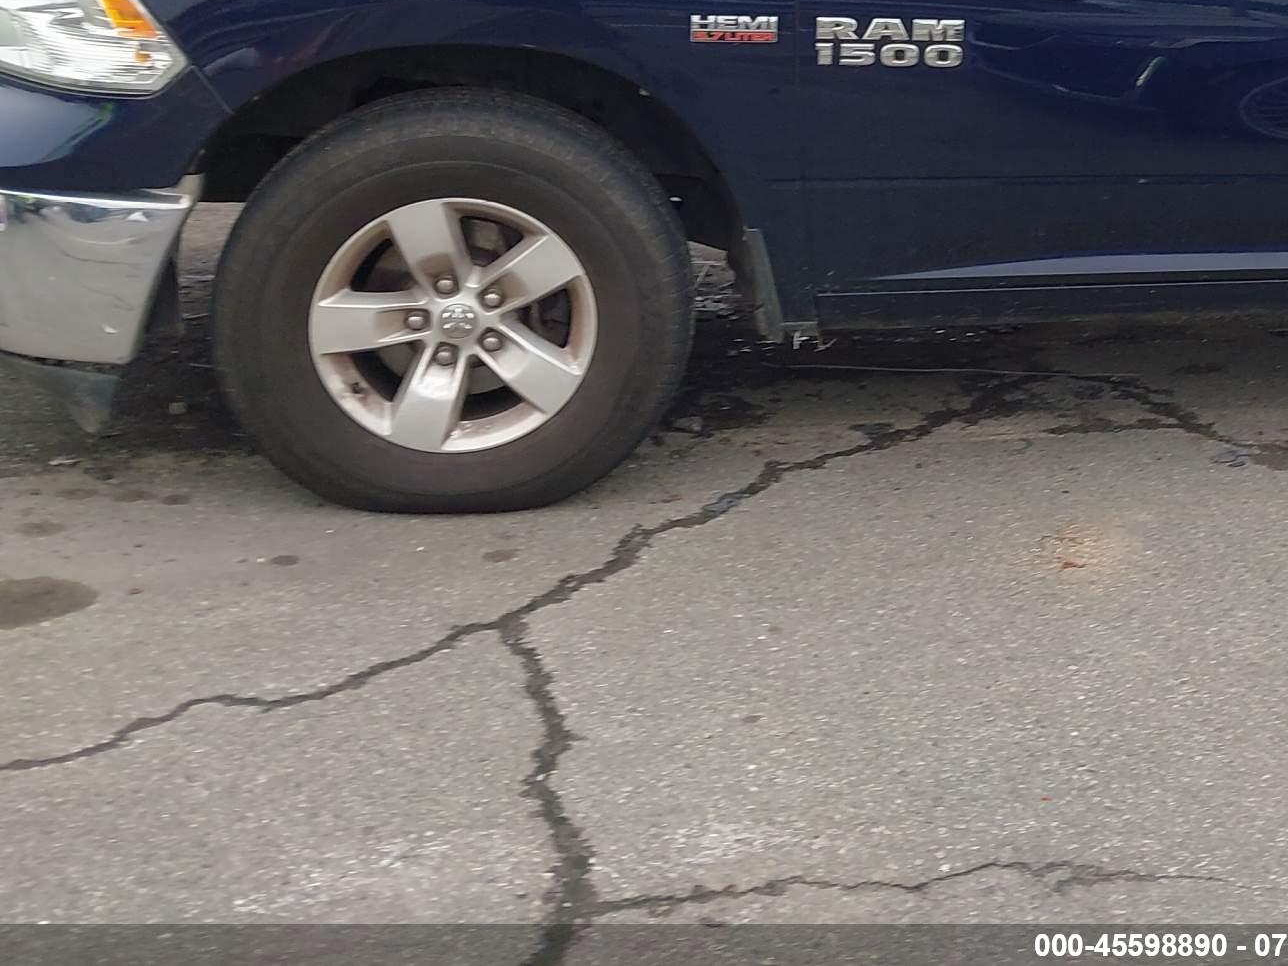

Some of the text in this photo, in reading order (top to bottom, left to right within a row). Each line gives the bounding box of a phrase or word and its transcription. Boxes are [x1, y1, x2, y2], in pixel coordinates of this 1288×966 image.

[690, 14, 778, 30] HEMI
[815, 16, 965, 41] RAM
[815, 43, 964, 67] 1500
